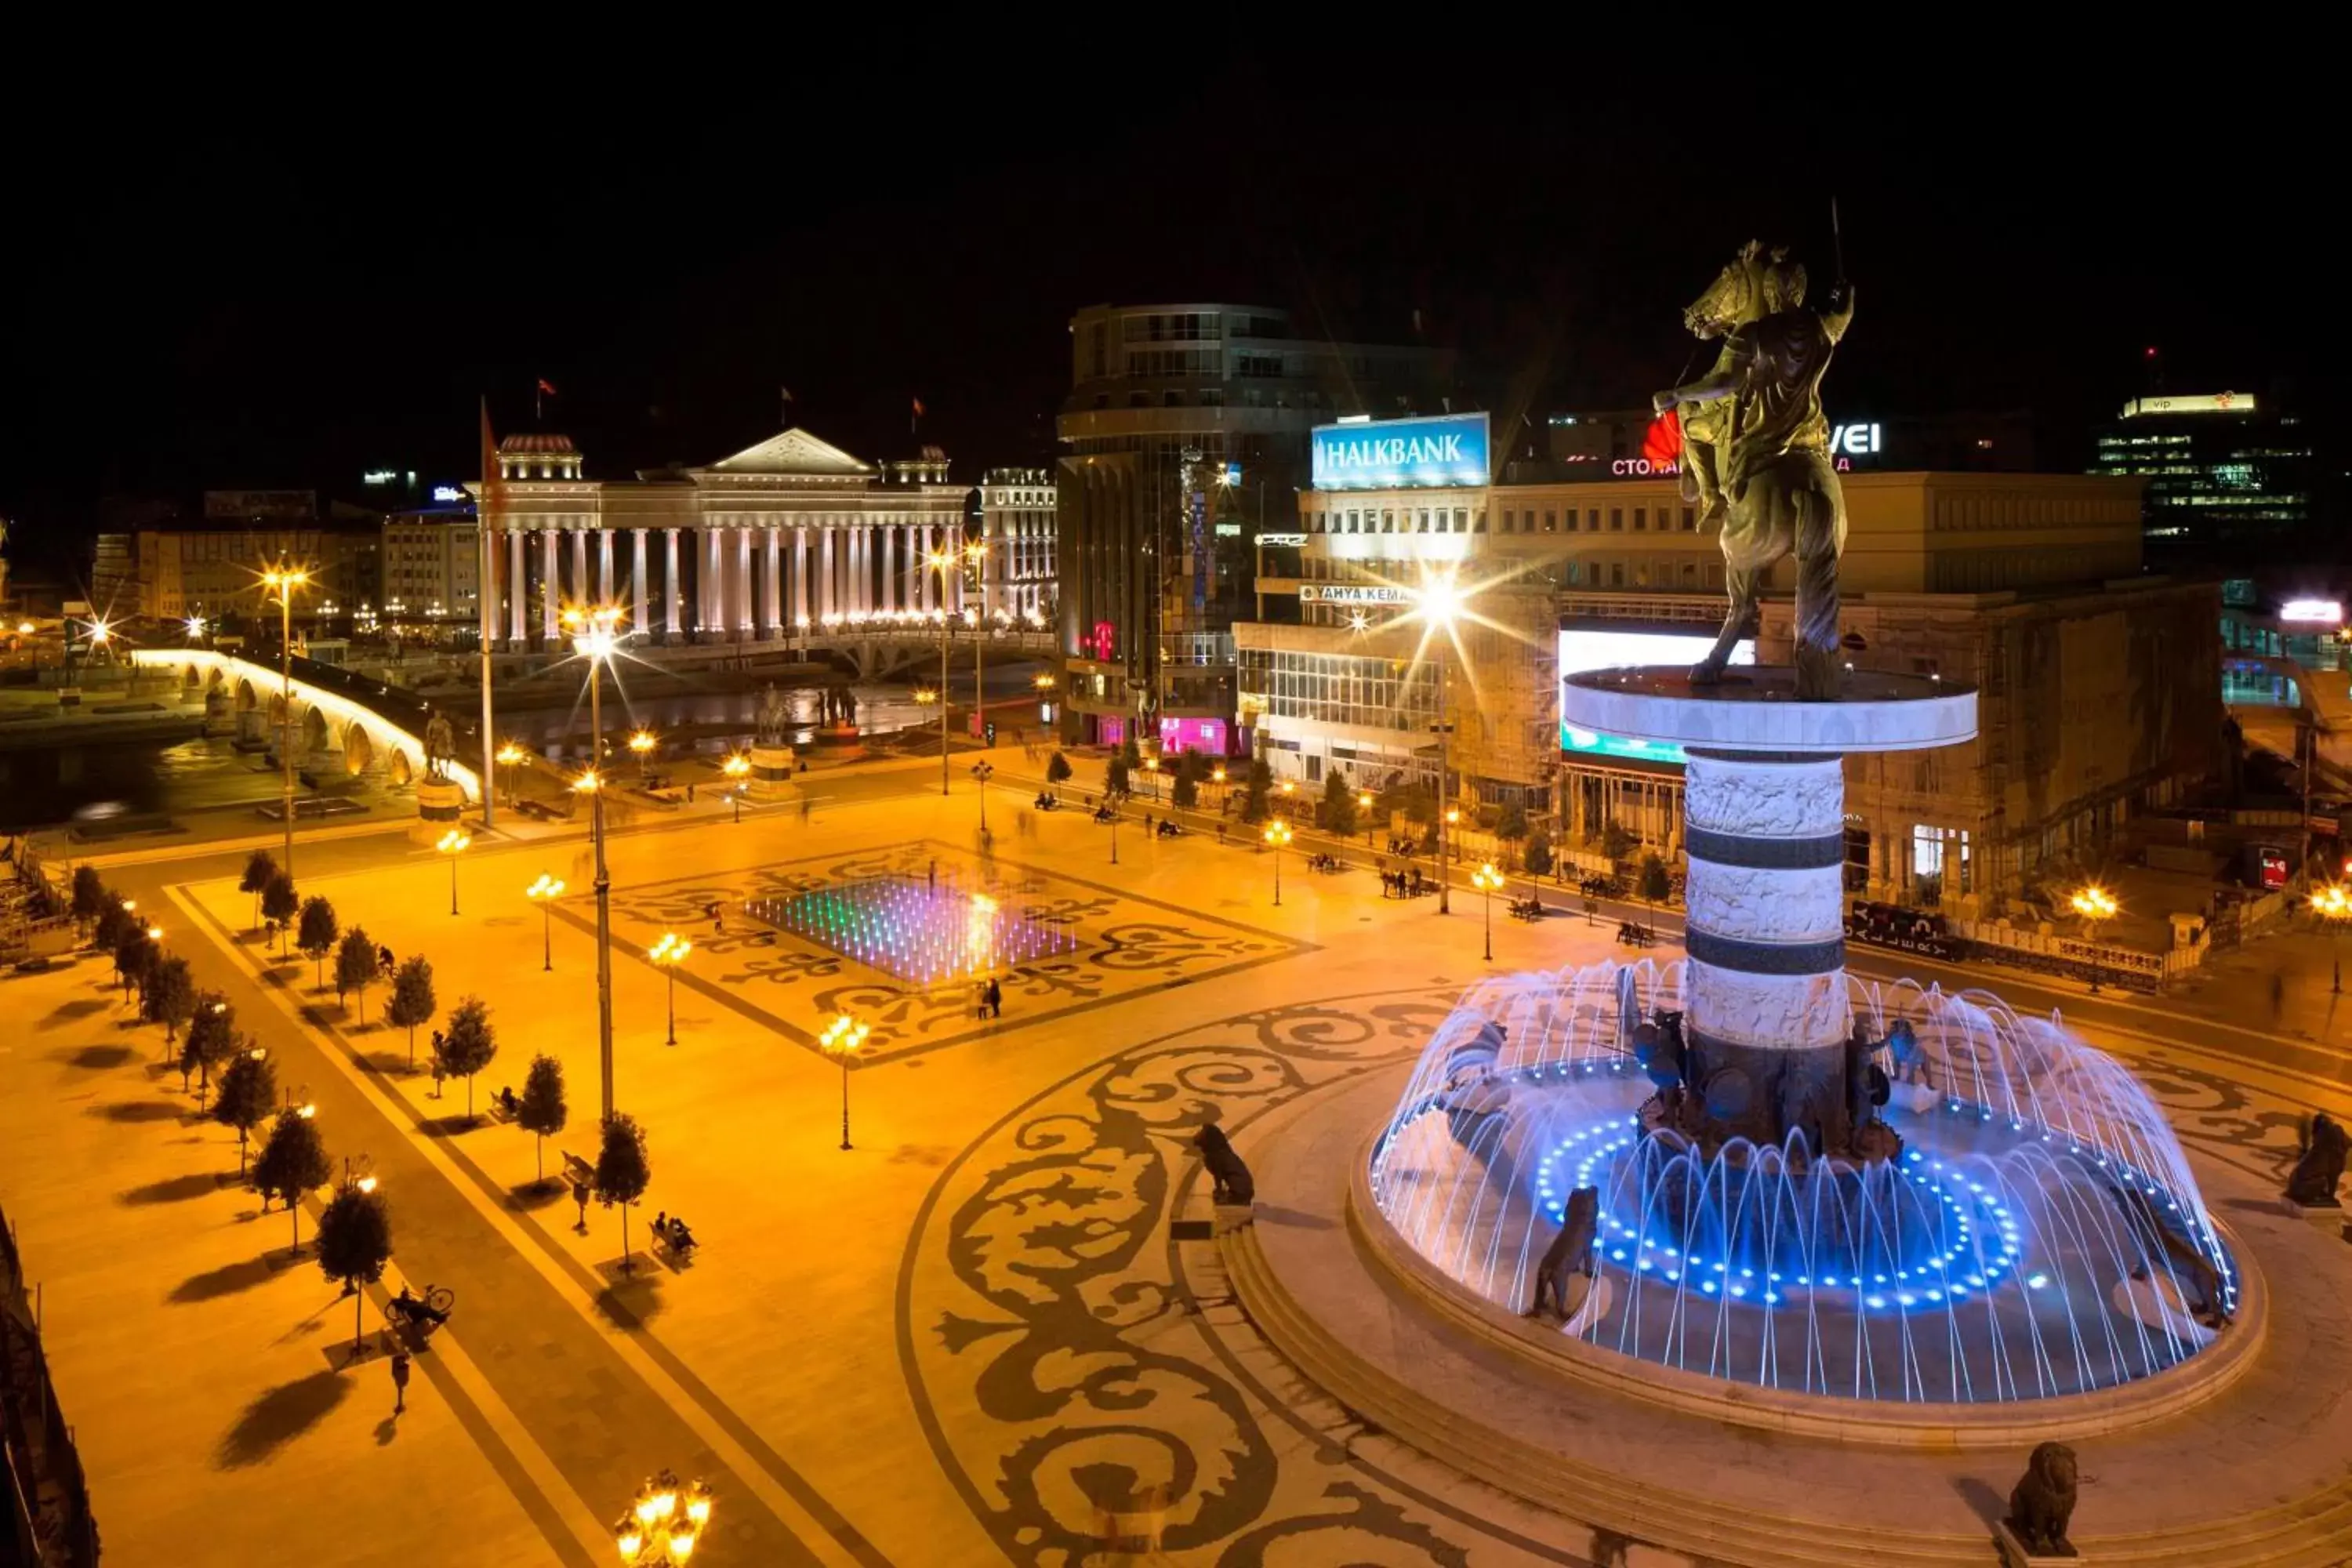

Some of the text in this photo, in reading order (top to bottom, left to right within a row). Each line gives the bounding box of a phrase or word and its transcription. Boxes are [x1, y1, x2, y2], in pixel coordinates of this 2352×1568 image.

[1327, 434, 1462, 469] HALKBANK
[1612, 459, 1683, 475] СТОА
[1318, 587, 1414, 601] YAHYA KEMA
